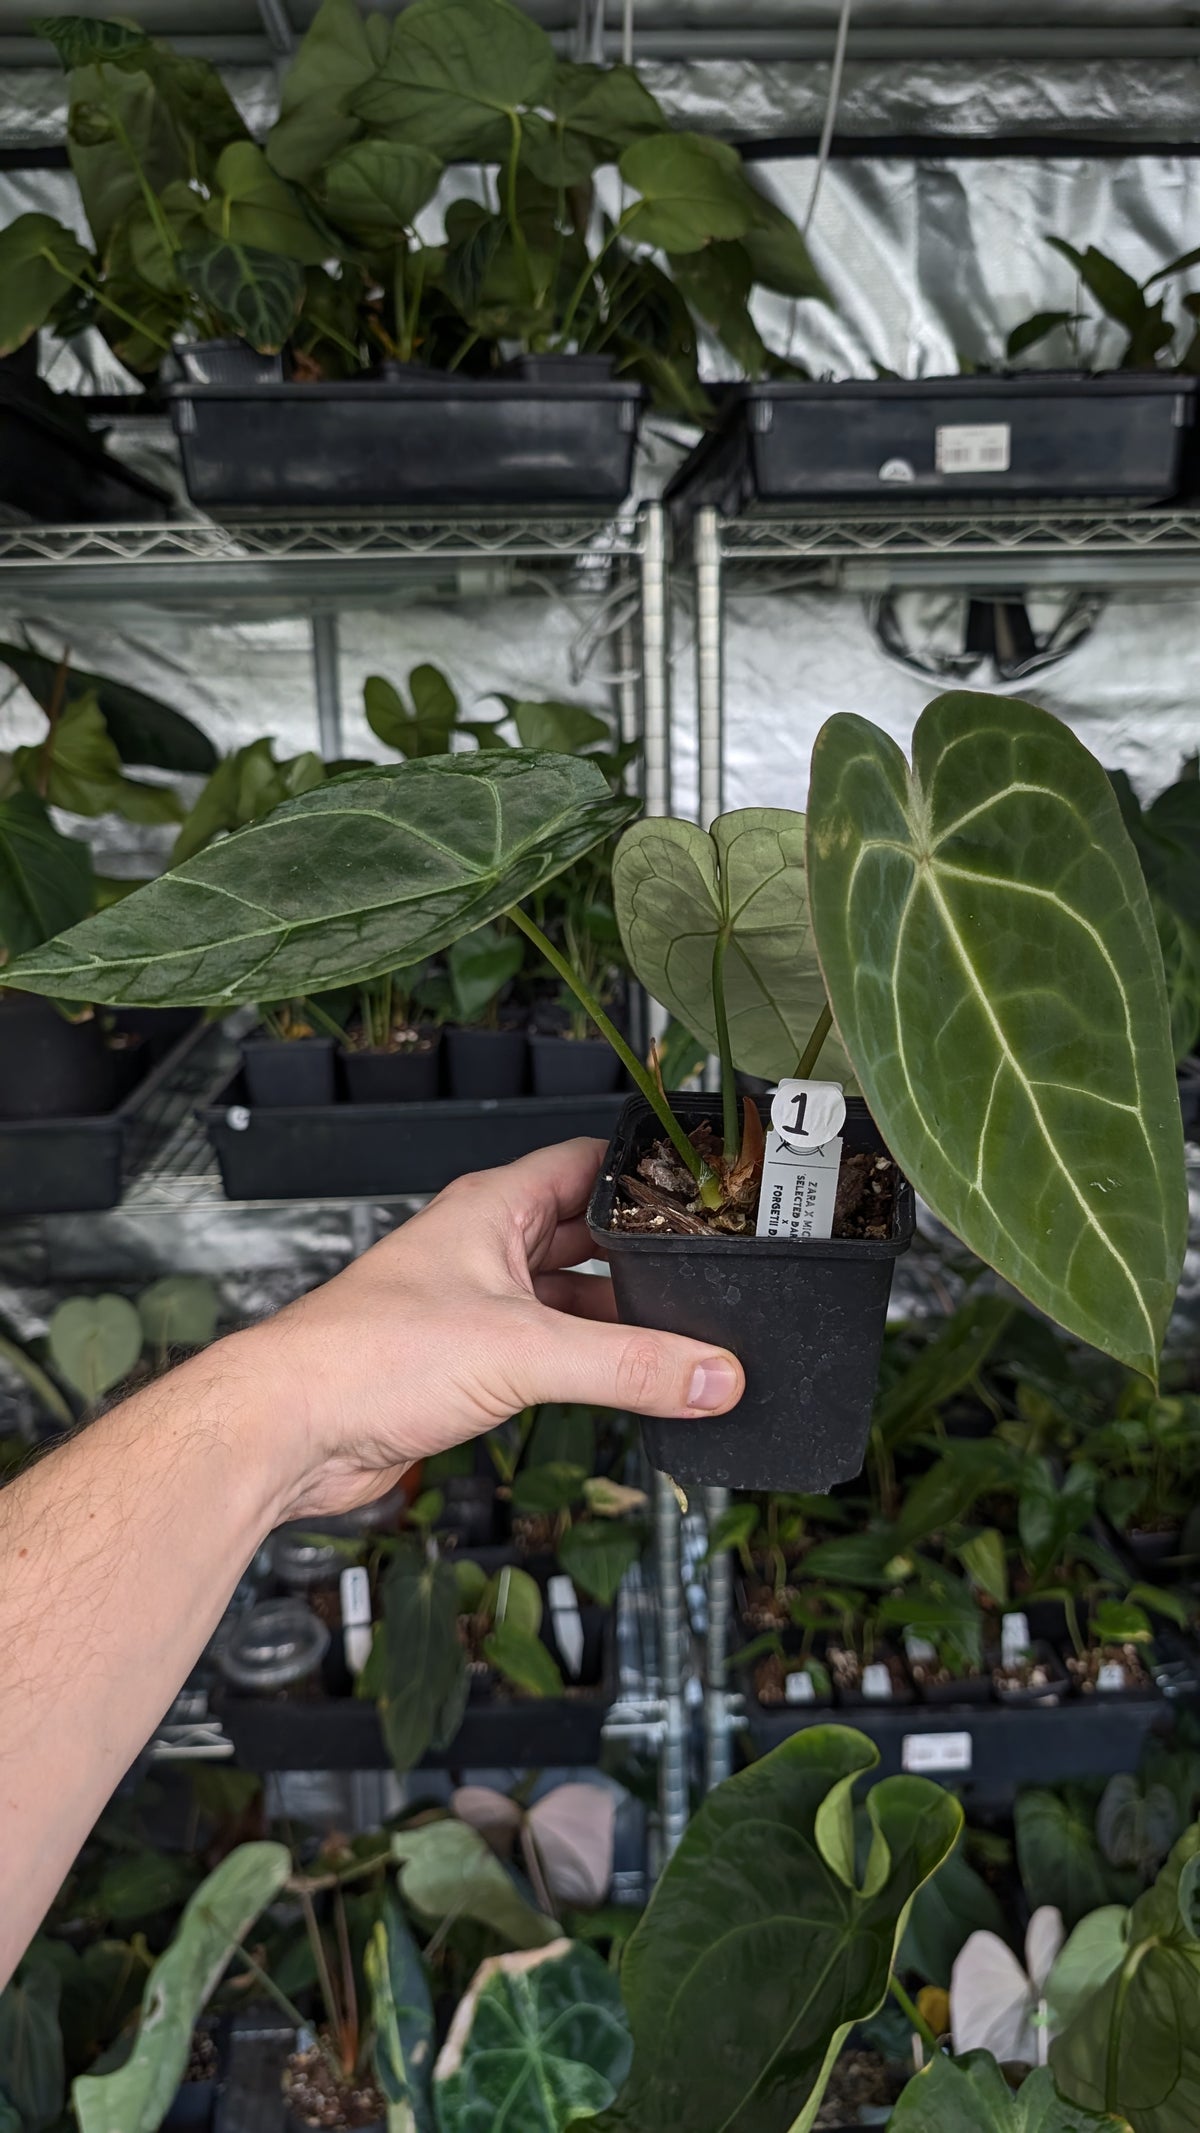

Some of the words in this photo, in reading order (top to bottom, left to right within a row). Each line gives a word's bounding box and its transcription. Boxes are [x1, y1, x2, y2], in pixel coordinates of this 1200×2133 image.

[782, 1092, 809, 1136] 1
[769, 1184, 783, 1226] FORGETII
[805, 1181, 818, 1207] ZARA
[768, 1228, 777, 1238] D
